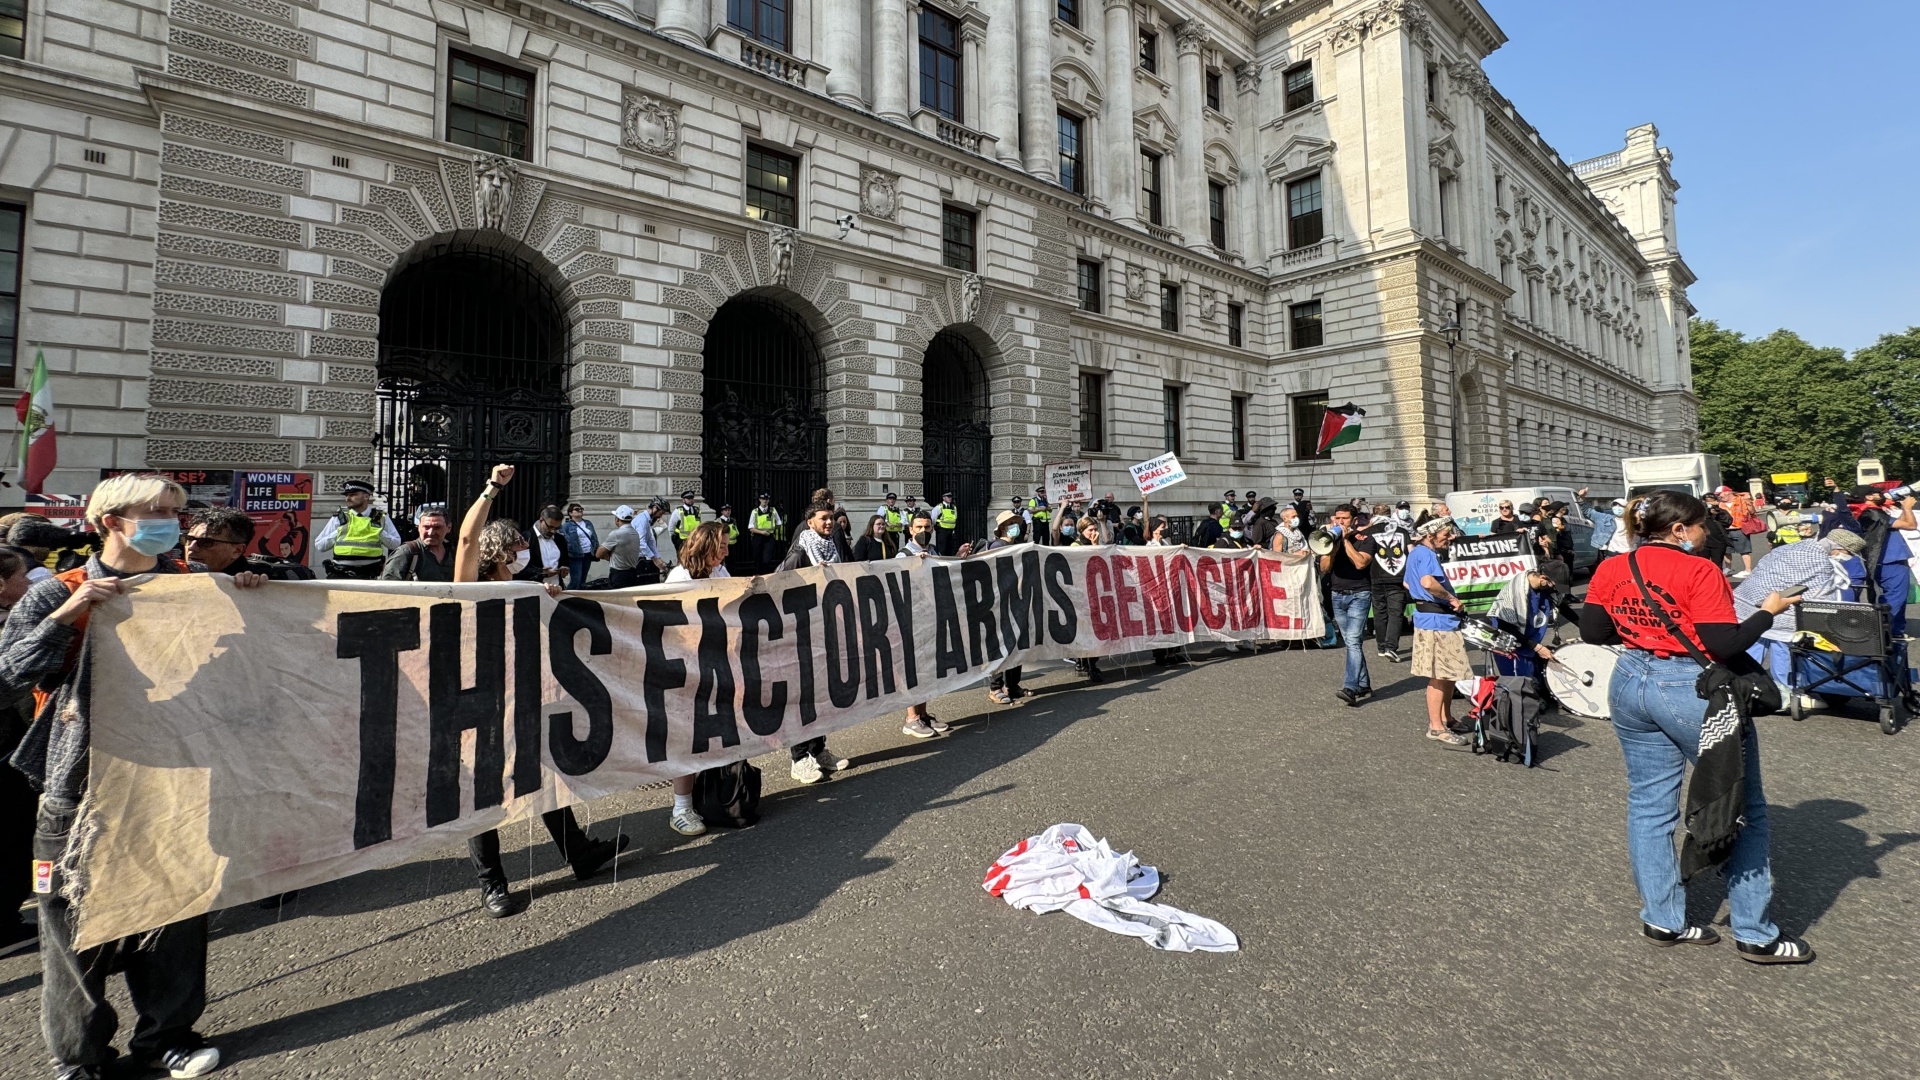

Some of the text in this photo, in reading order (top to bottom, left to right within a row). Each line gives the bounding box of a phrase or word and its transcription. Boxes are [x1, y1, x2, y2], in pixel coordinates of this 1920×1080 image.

[1144, 460, 1157, 471] GOV
[248, 473, 291, 483] WOMEN
[247, 487, 272, 497] LIFE
[45, 499, 61, 507] WHY
[64, 499, 81, 507] BAN
[246, 500, 299, 511] FREEDOM
[44, 508, 75, 517] TERROR
[1446, 560, 1526, 581] UPATION
[1627, 616, 1662, 628] NOW
[337, 550, 1303, 850] THIS FACTORY ARMS GENOCIDE.
